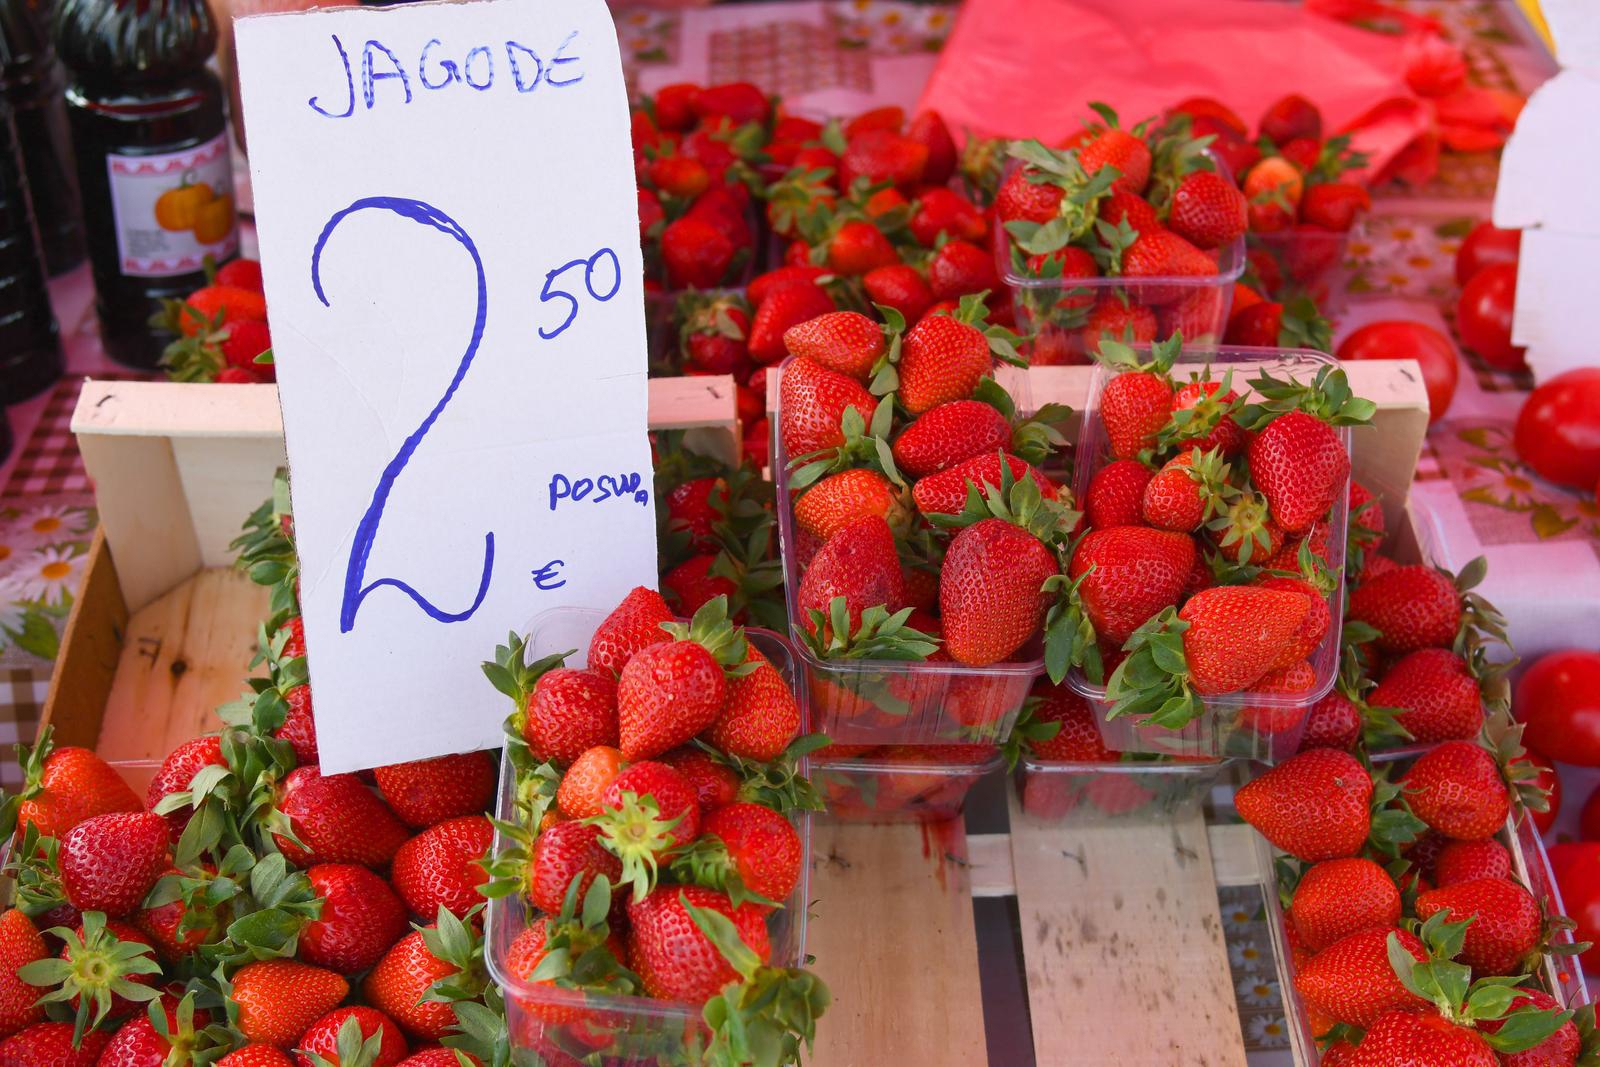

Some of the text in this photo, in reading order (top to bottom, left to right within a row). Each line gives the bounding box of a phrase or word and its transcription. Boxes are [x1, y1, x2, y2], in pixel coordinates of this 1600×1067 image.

[309, 31, 585, 118] JAGODE
[312, 196, 621, 633] 2 50
[531, 560, 566, 590] €
